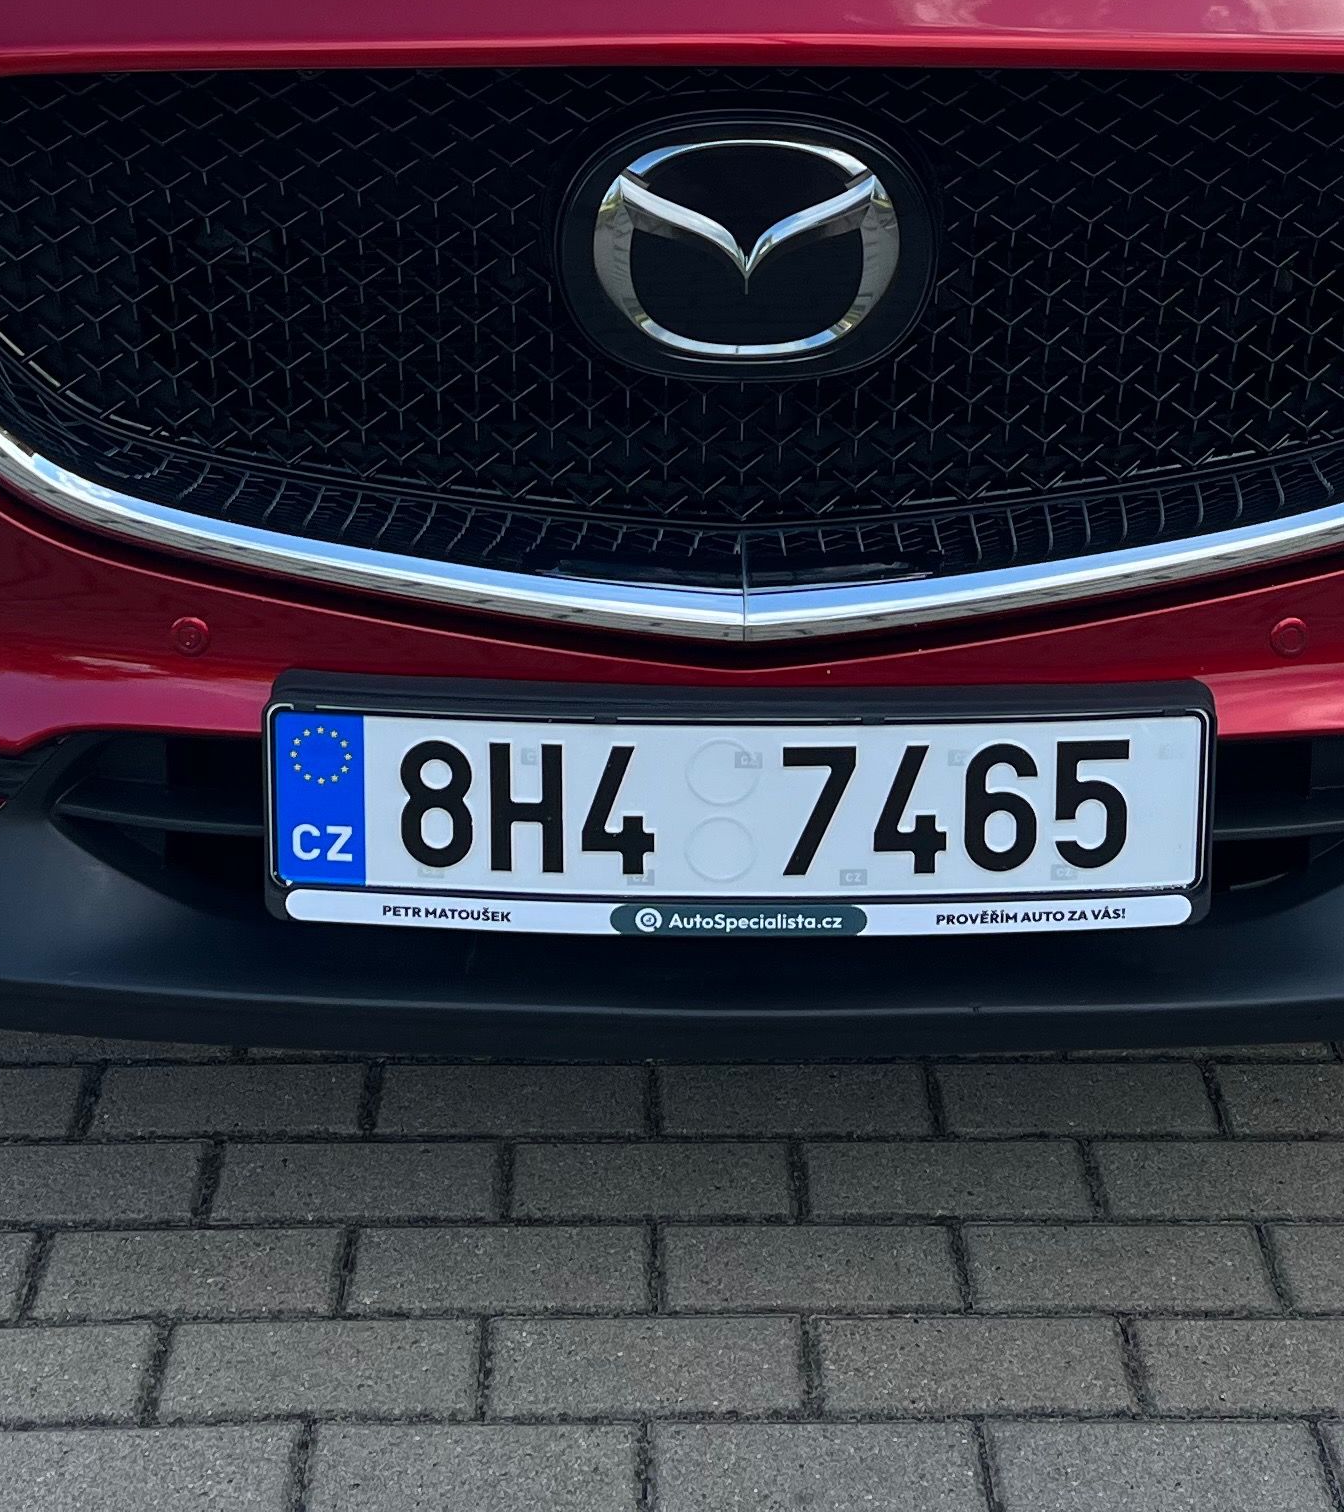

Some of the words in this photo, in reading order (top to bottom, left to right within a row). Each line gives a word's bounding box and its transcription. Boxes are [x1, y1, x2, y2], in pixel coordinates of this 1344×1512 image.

[400, 739, 656, 876] 8H4
[782, 738, 1131, 876] 7465
[291, 823, 354, 862] CZ
[382, 904, 422, 918] PETR
[425, 906, 512, 923] MATOUŠEK
[668, 913, 843, 932] AutoSpecialista.cz
[935, 909, 1018, 926] PROVĚŘÍM
[1020, 910, 1065, 923] AUTO
[1067, 910, 1089, 922] ZA
[1090, 905, 1127, 921] VÁS!
